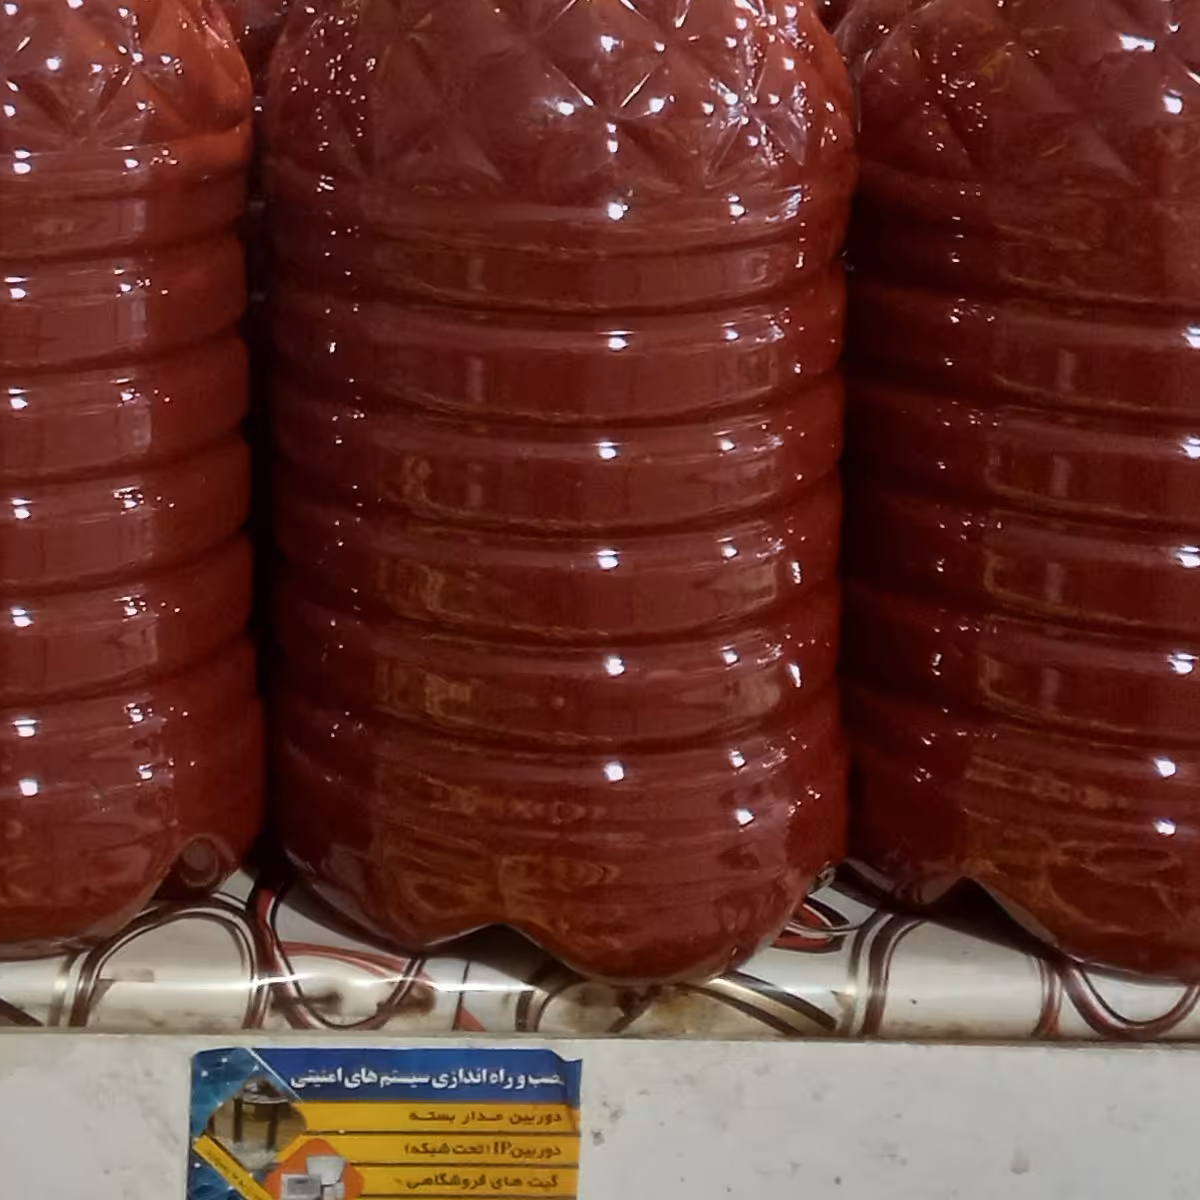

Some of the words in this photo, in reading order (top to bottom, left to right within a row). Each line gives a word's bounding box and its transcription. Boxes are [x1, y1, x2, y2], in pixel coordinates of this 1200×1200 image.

[290, 1066, 343, 1089] امنیتی
[343, 1067, 378, 1089] های
[431, 1067, 488, 1089] اندازی
[489, 1067, 513, 1090] راه
[408, 1110, 456, 1123] بسته
[460, 1110, 503, 1126] مدار
[509, 1110, 563, 1126] دوربین
